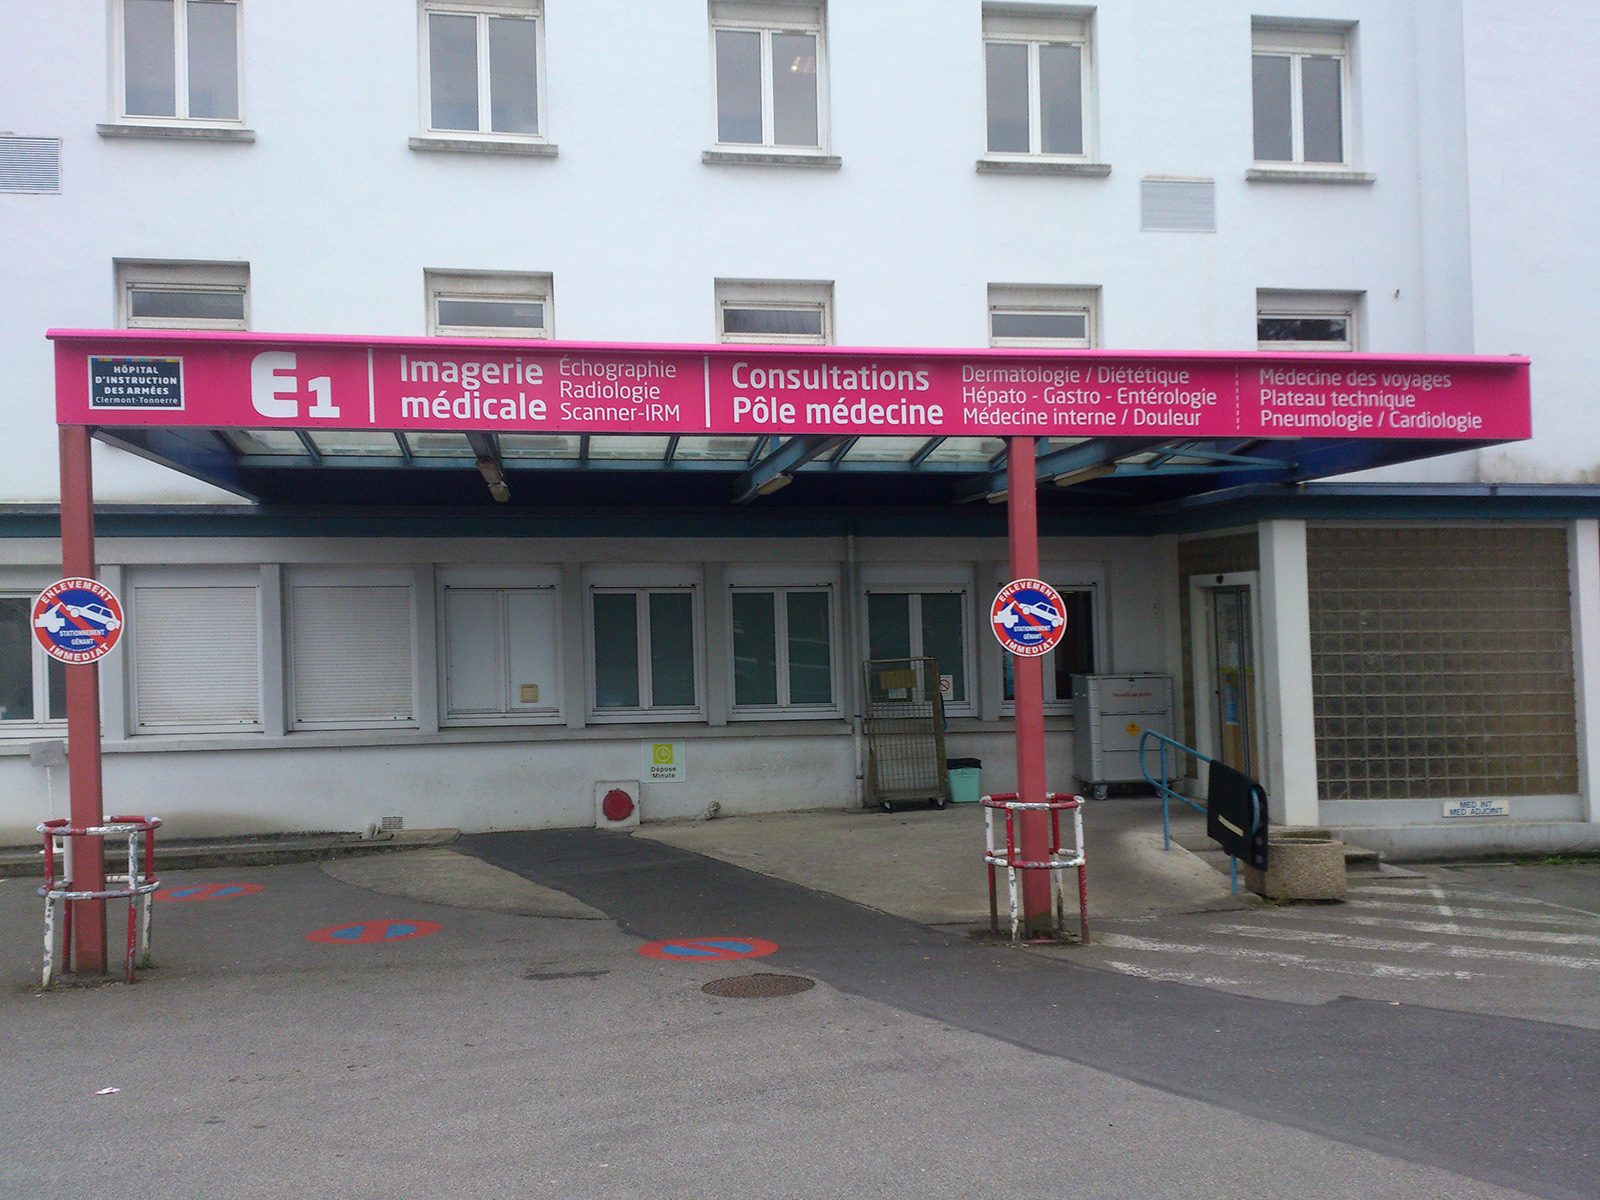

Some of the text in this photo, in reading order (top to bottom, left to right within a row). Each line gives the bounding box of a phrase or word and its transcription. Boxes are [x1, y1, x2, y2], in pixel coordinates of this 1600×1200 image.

[113, 364, 158, 374] HÔPITAL
[401, 356, 544, 391] Imagerie
[559, 354, 676, 382] Échographie
[732, 362, 930, 392] Consultations
[962, 365, 1189, 388] Dermatologie / Diététique
[95, 376, 177, 384] D'INSTRUCTION
[250, 351, 341, 419] E1
[1259, 368, 1451, 392] Médecine des voyages
[96, 396, 178, 404] Clermont-Tonnerre
[560, 381, 660, 403] Radiologie
[963, 387, 1027, 409] Hépato
[1044, 388, 1101, 405] Gastro
[1117, 388, 1218, 409] Entérologie
[1260, 389, 1416, 412] Plateau technique
[401, 391, 547, 421] médicale
[561, 403, 680, 422] Scanner-IRM
[733, 397, 943, 425] Pôle médecine
[963, 408, 1201, 427] Médecine interne / Douleur
[1261, 411, 1483, 433] Pneumologie / Cardiologie
[41, 581, 113, 604] ENLEVEMENT
[998, 582, 1058, 602] ENLEVEMENT
[49, 643, 109, 660] IMMEDIAT
[1005, 638, 1054, 654] IMMEDIAT
